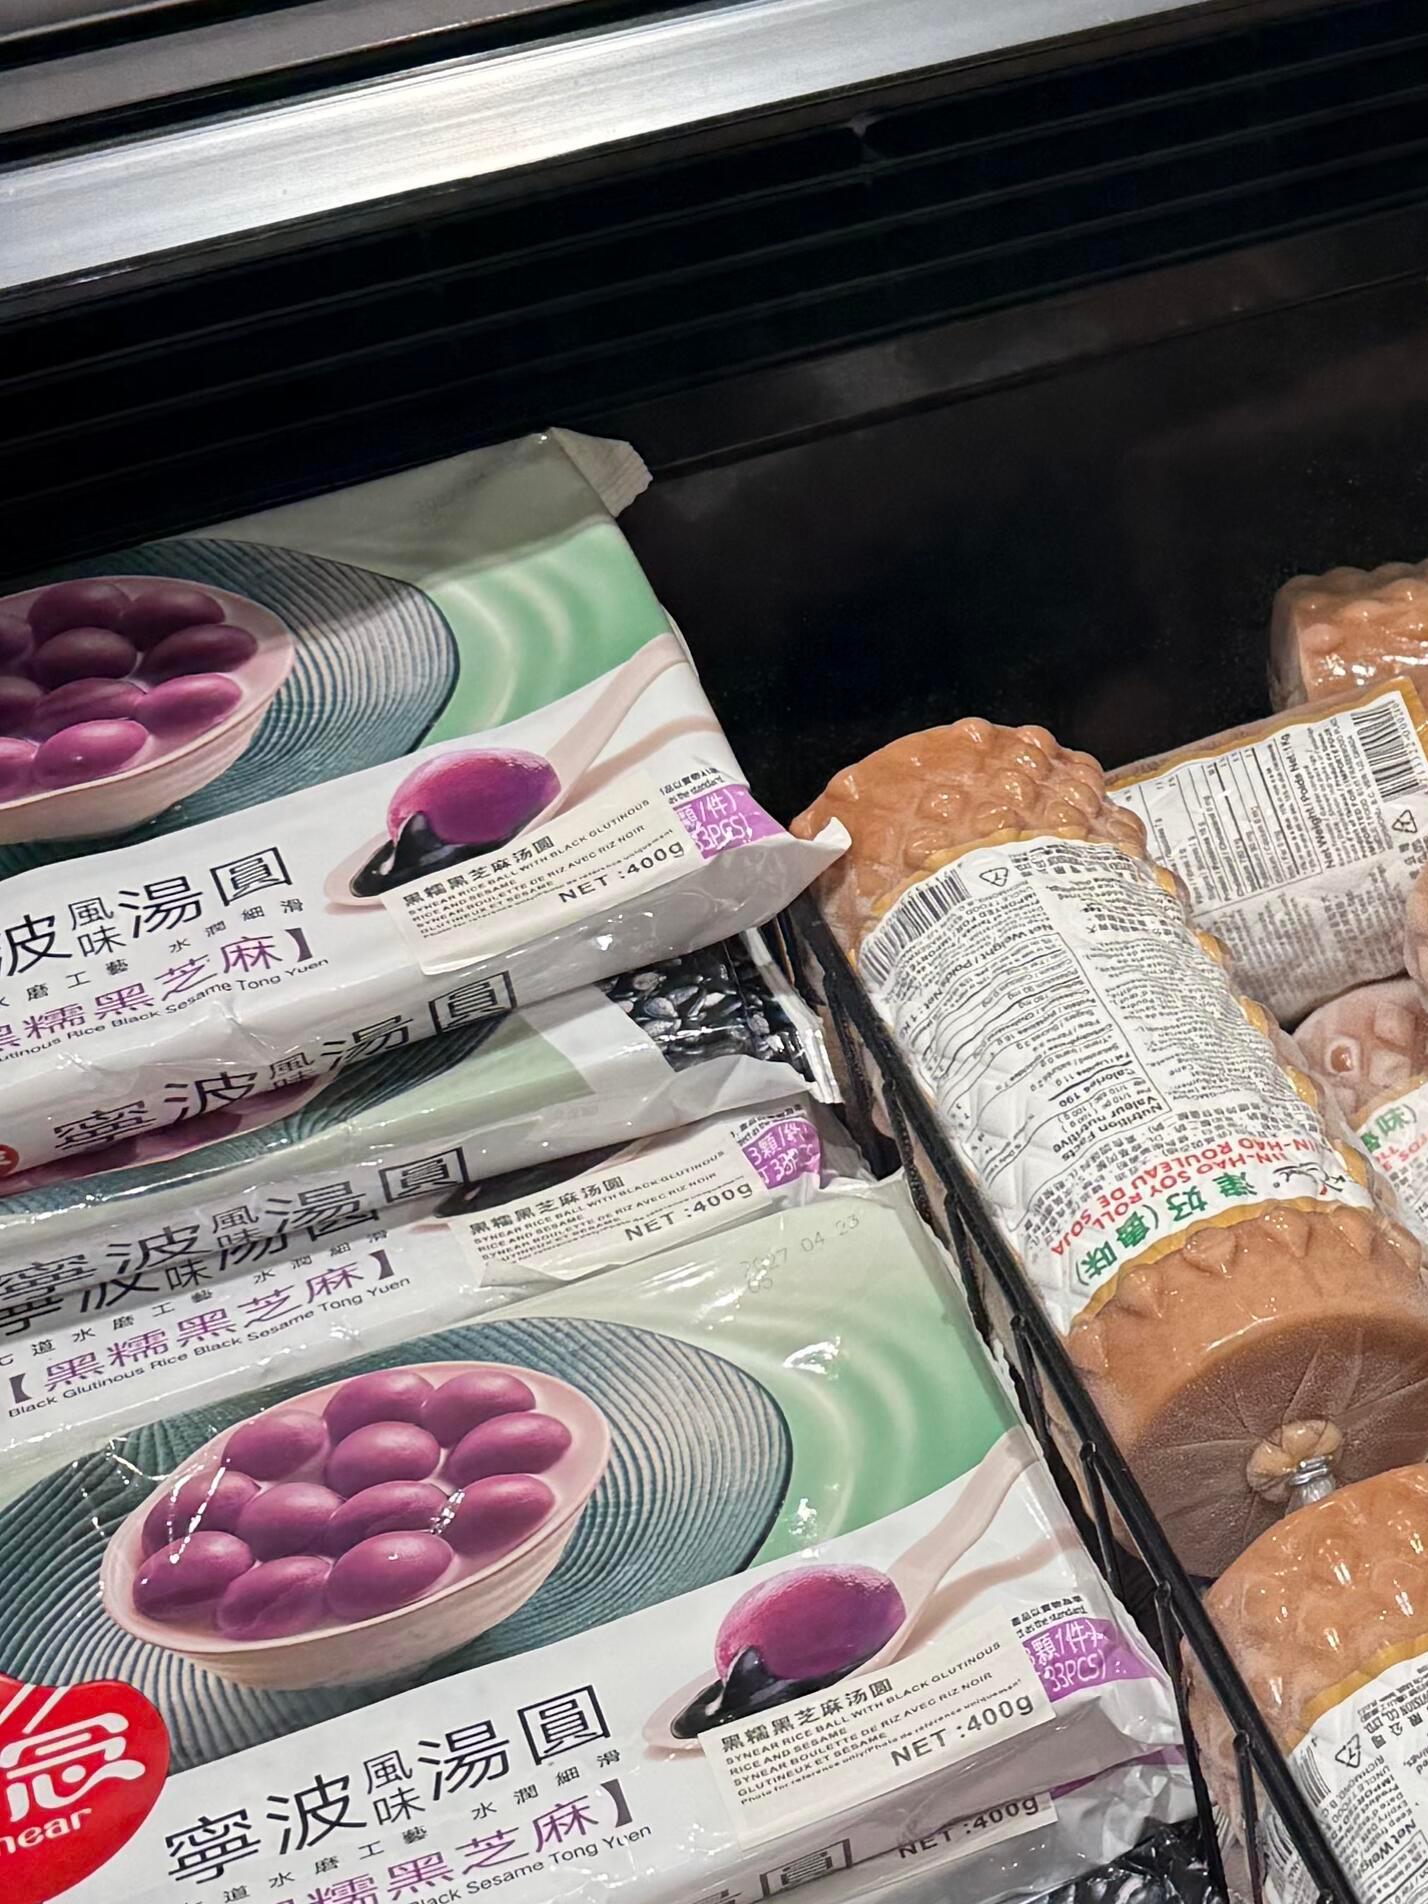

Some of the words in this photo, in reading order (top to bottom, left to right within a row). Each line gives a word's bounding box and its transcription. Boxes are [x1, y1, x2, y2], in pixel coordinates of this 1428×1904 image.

[164, 978, 233, 1016] Sesame
[235, 969, 281, 994] Tong
[285, 955, 330, 978] Yuen
[1099, 1101, 1163, 1135] Nutrition
[1128, 1138, 1231, 1190] ROULEAU
[1138, 1170, 1190, 1200] SOY
[1096, 1186, 1125, 1208] DE
[624, 1212, 675, 1242] NET
[7, 1390, 58, 1419] Black
[61, 1363, 146, 1401] Glutinous
[150, 1351, 188, 1371] Rice
[193, 1334, 242, 1356] Black
[246, 1308, 315, 1342] Sesame
[317, 1291, 365, 1317] Tong
[366, 1276, 411, 1299] Yuen
[889, 1727, 951, 1767] NET
[954, 1691, 1035, 1739] :400g
[0, 1707, 150, 1822] 念
[153, 1682, 613, 1893] 寧波風味湯圓
[469, 1747, 623, 1821] 水潤細滑
[465, 1858, 545, 1895] Sesame
[548, 1839, 599, 1869] Tong
